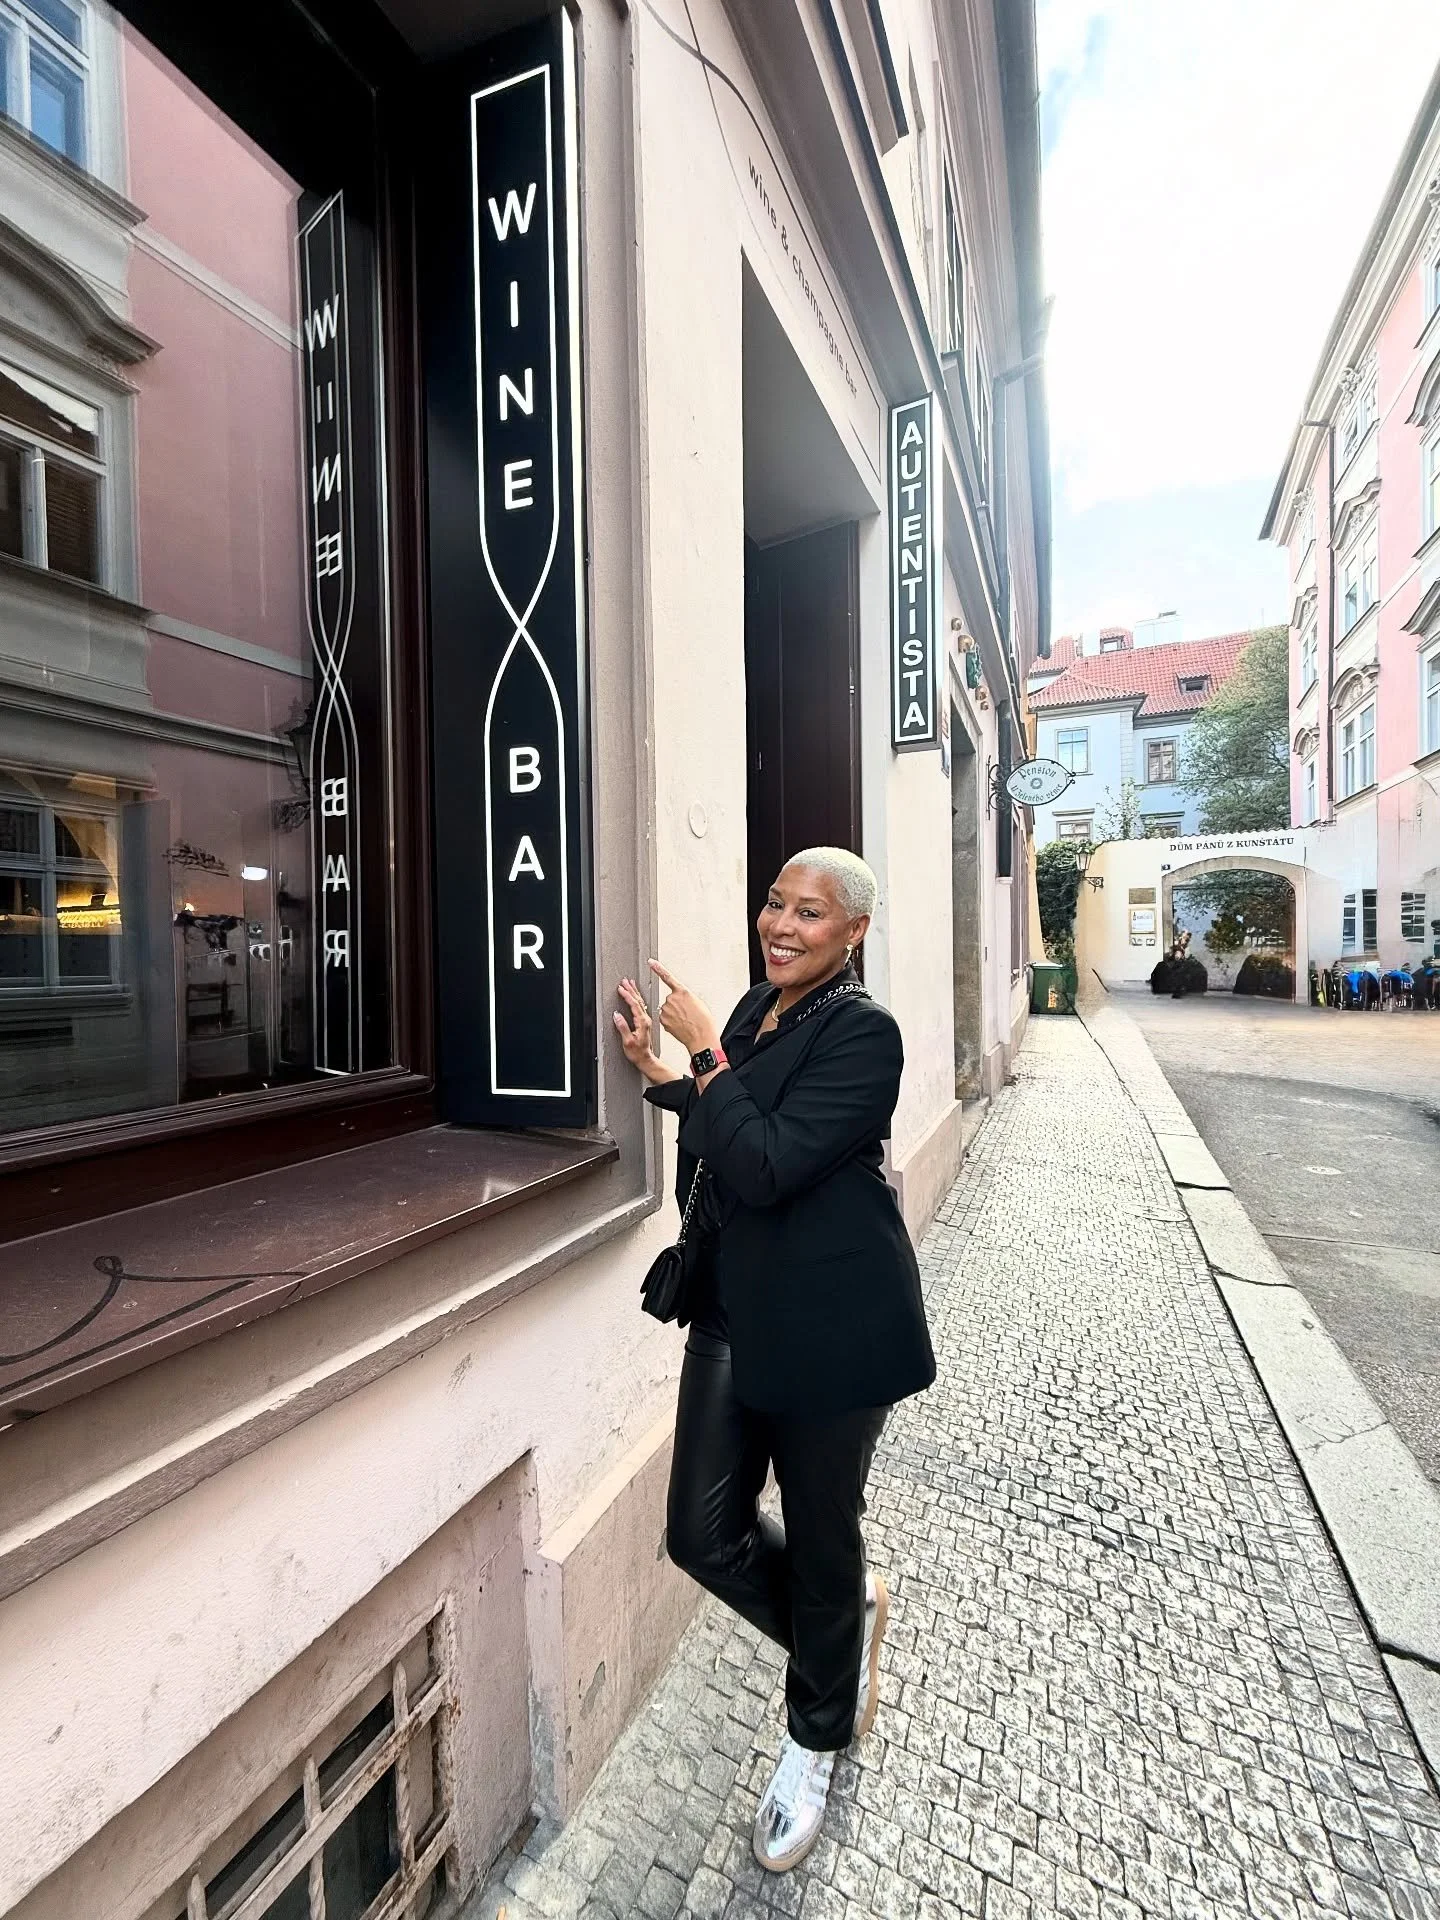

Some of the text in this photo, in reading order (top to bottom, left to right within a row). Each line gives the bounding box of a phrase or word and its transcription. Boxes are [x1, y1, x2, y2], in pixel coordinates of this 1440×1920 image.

[487, 181, 537, 511] WINE
[747, 155, 859, 400] wine & champagne bar
[899, 419, 926, 729] AUTENTISTA
[507, 745, 545, 971] BAR
[1017, 765, 1057, 781] Pension
